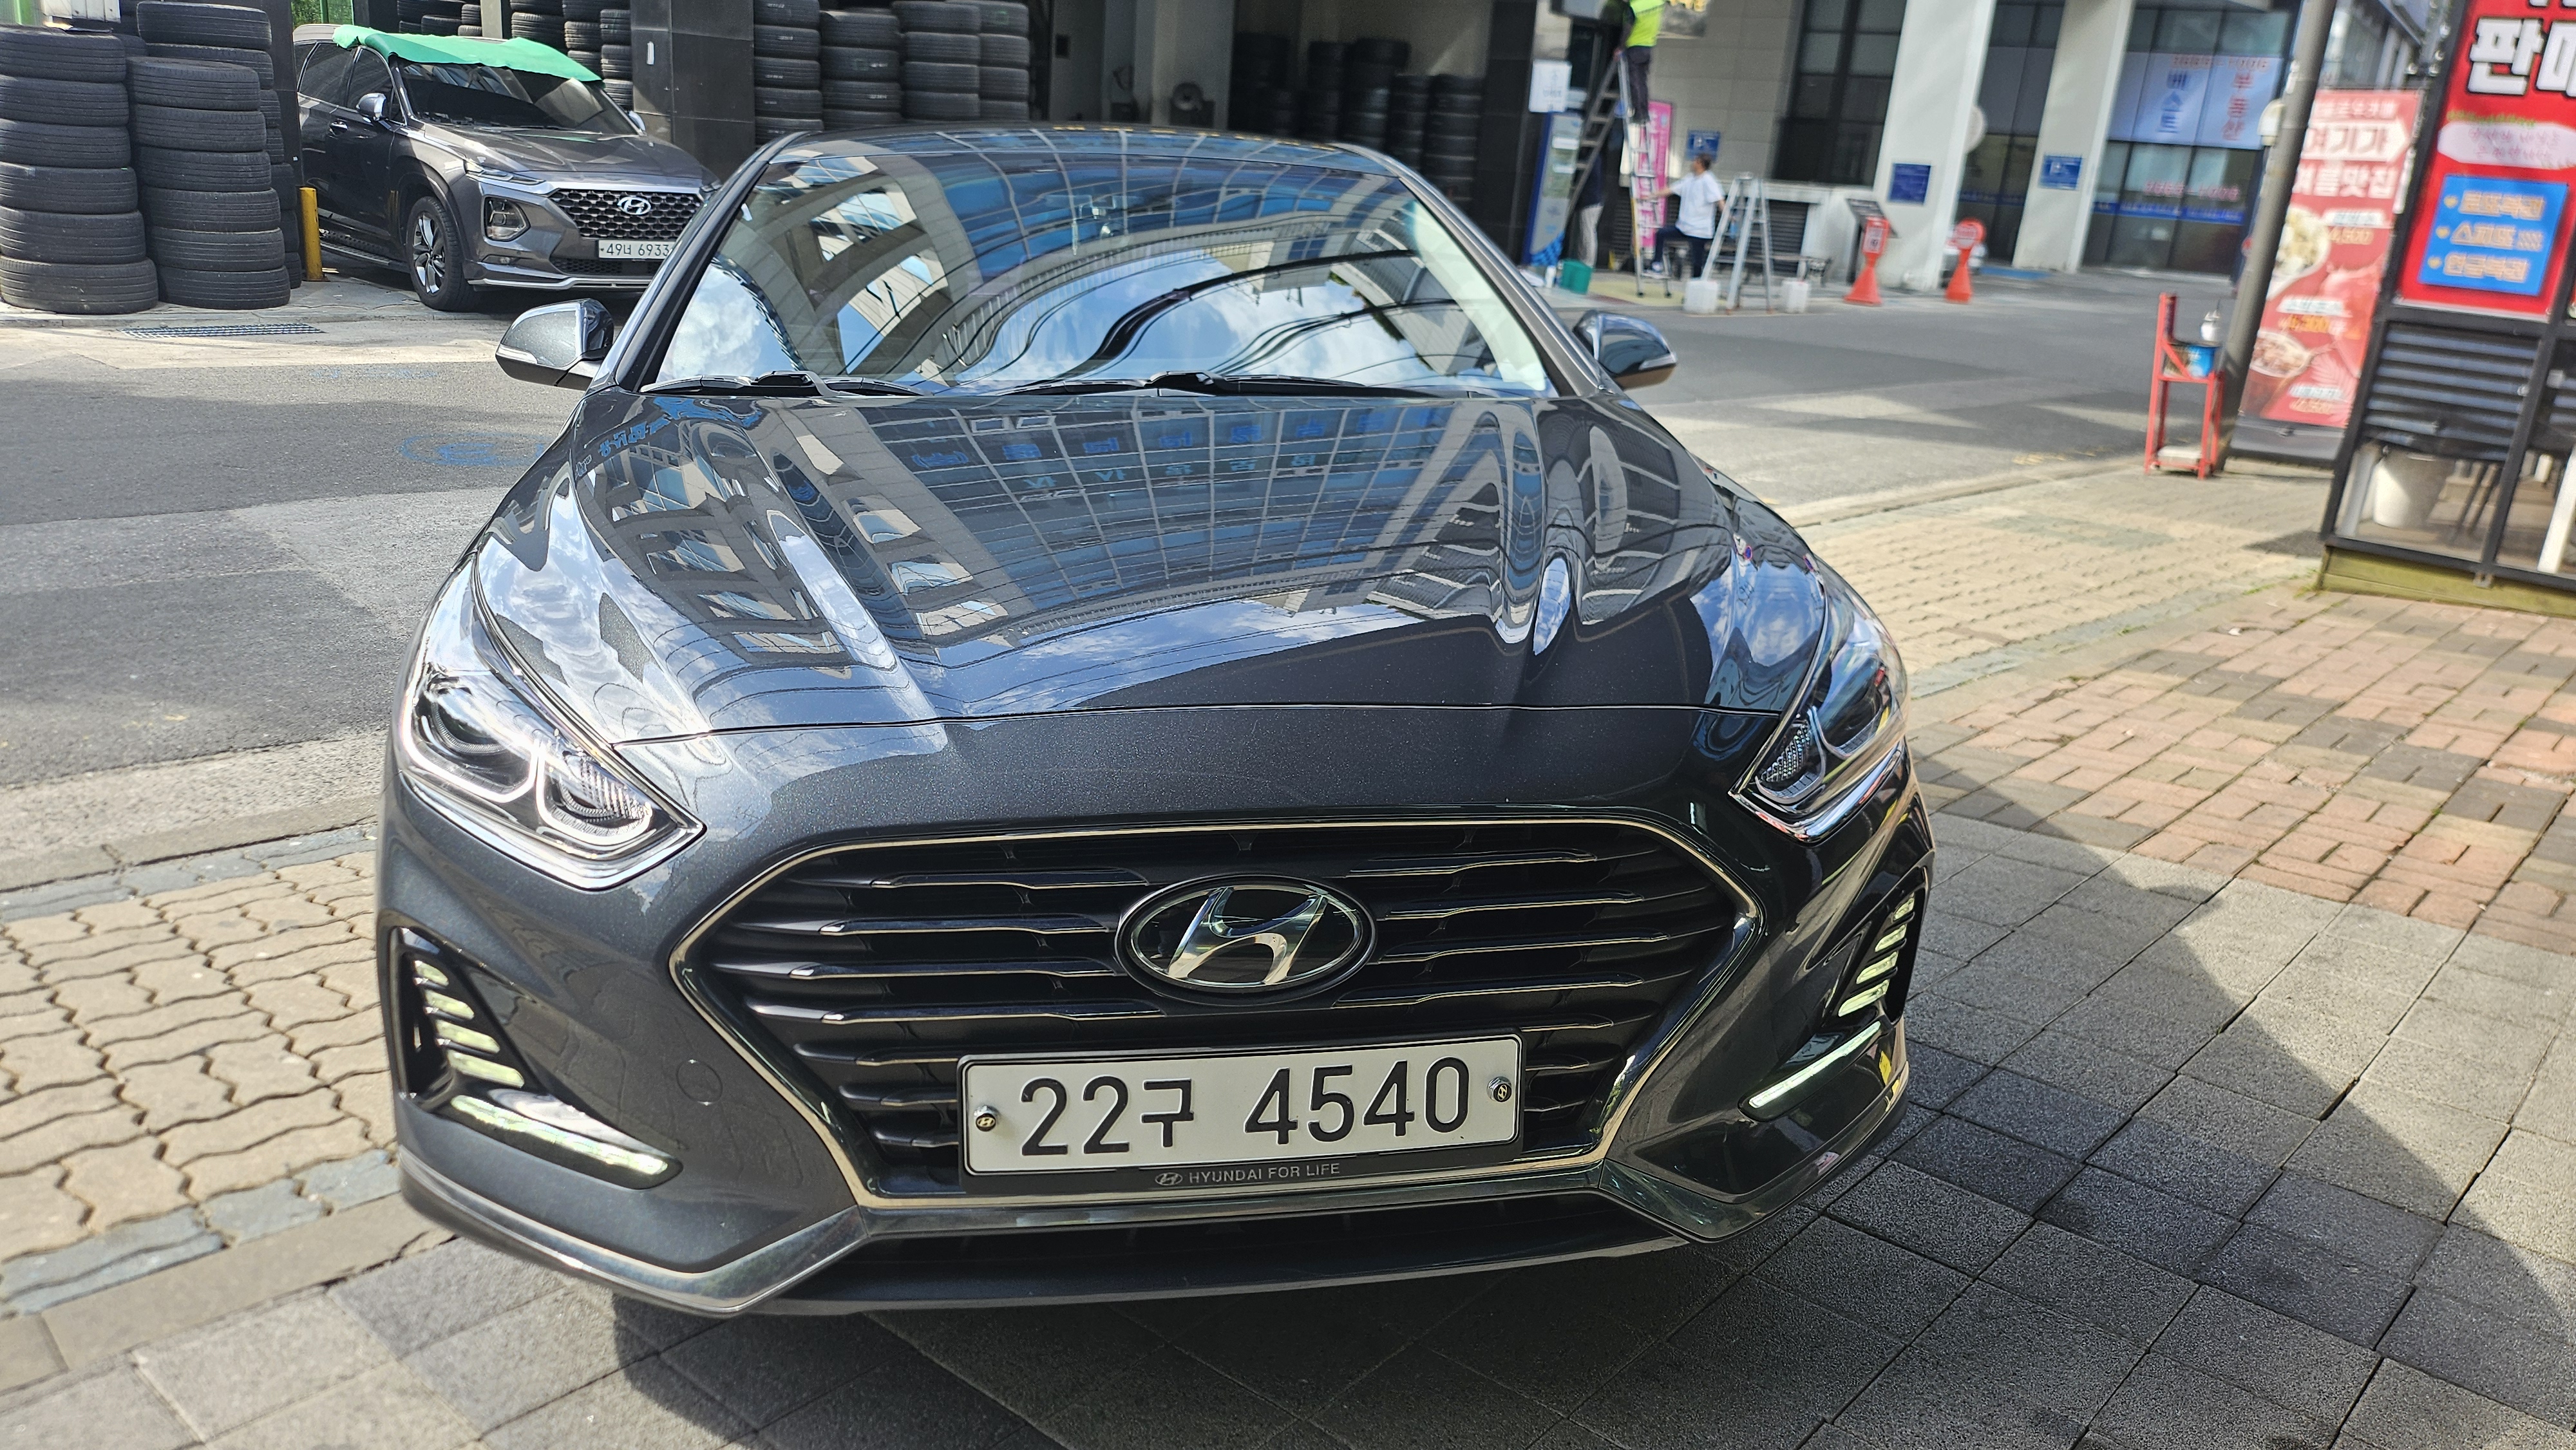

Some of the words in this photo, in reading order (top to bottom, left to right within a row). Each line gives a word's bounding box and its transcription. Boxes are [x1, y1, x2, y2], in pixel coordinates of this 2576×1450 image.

[2222, 71, 2254, 141] 부동산
[606, 243, 632, 256] 49너
[638, 243, 670, 257] 6933
[1021, 1075, 1195, 1156] 22구
[1244, 1057, 1470, 1145] 4540
[1189, 1169, 1262, 1184] HYUNDAI
[1268, 1165, 1300, 1178] FOR
[1307, 1163, 1341, 1176] LIFE
